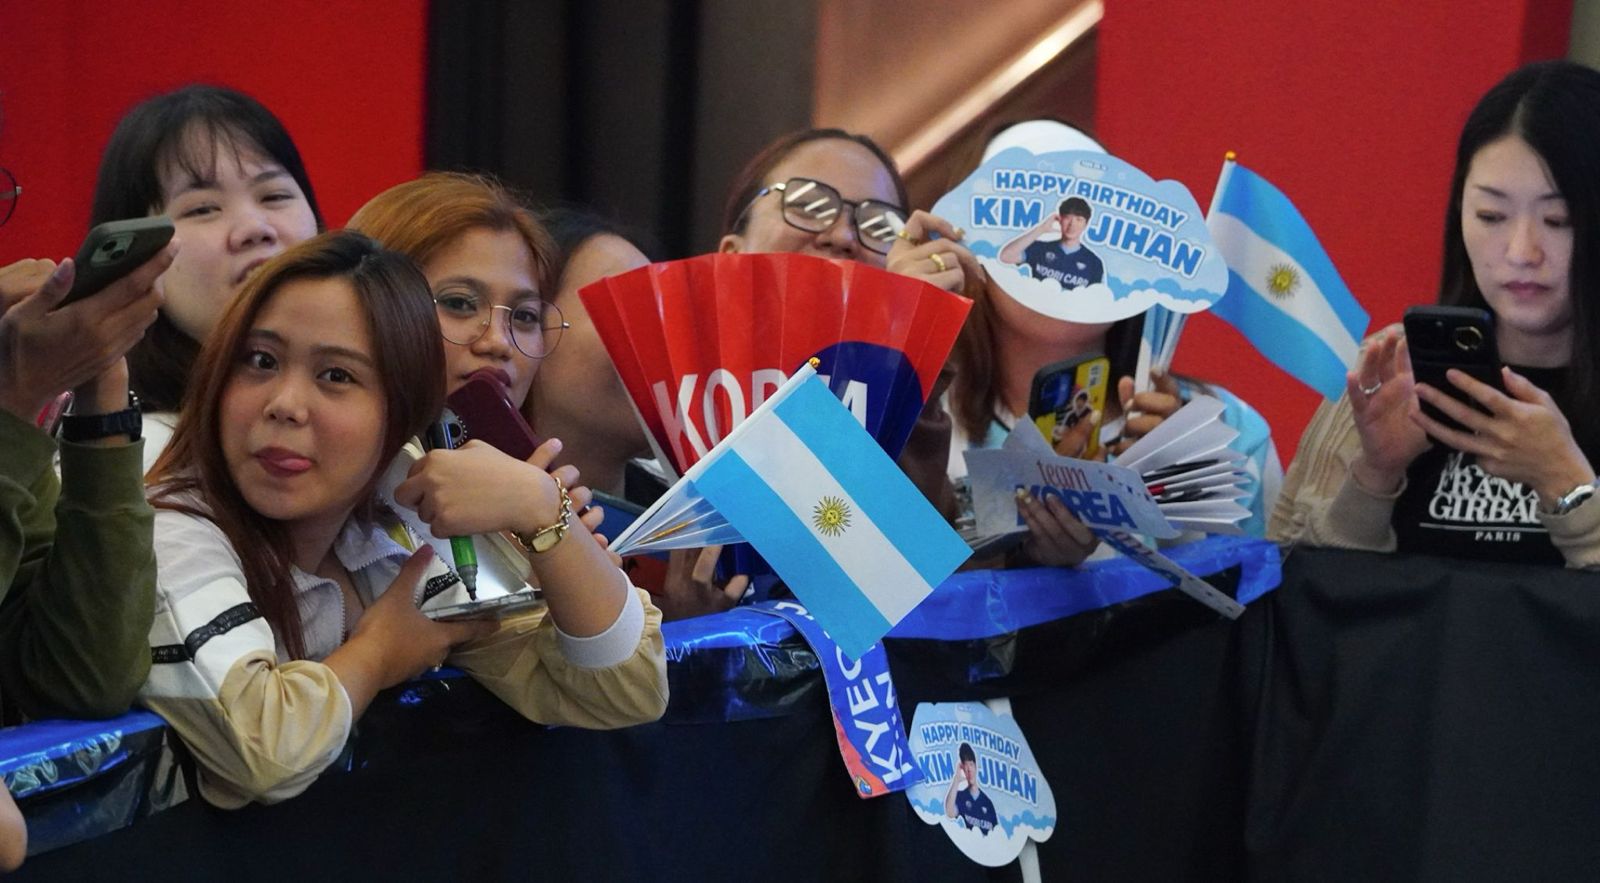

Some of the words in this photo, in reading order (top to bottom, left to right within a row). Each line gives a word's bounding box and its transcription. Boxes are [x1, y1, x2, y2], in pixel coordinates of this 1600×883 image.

[996, 171, 1073, 195] HAPPY
[1076, 180, 1186, 230] BIRTHDAY
[972, 197, 1043, 228] KIM
[1087, 215, 1205, 277] JIHAN
[1036, 459, 1092, 491] team
[1475, 531, 1521, 542] PARIS
[921, 724, 959, 745] HAPPY
[961, 727, 1020, 761] BIRTHDAY
[978, 756, 1037, 804] JIHAN
